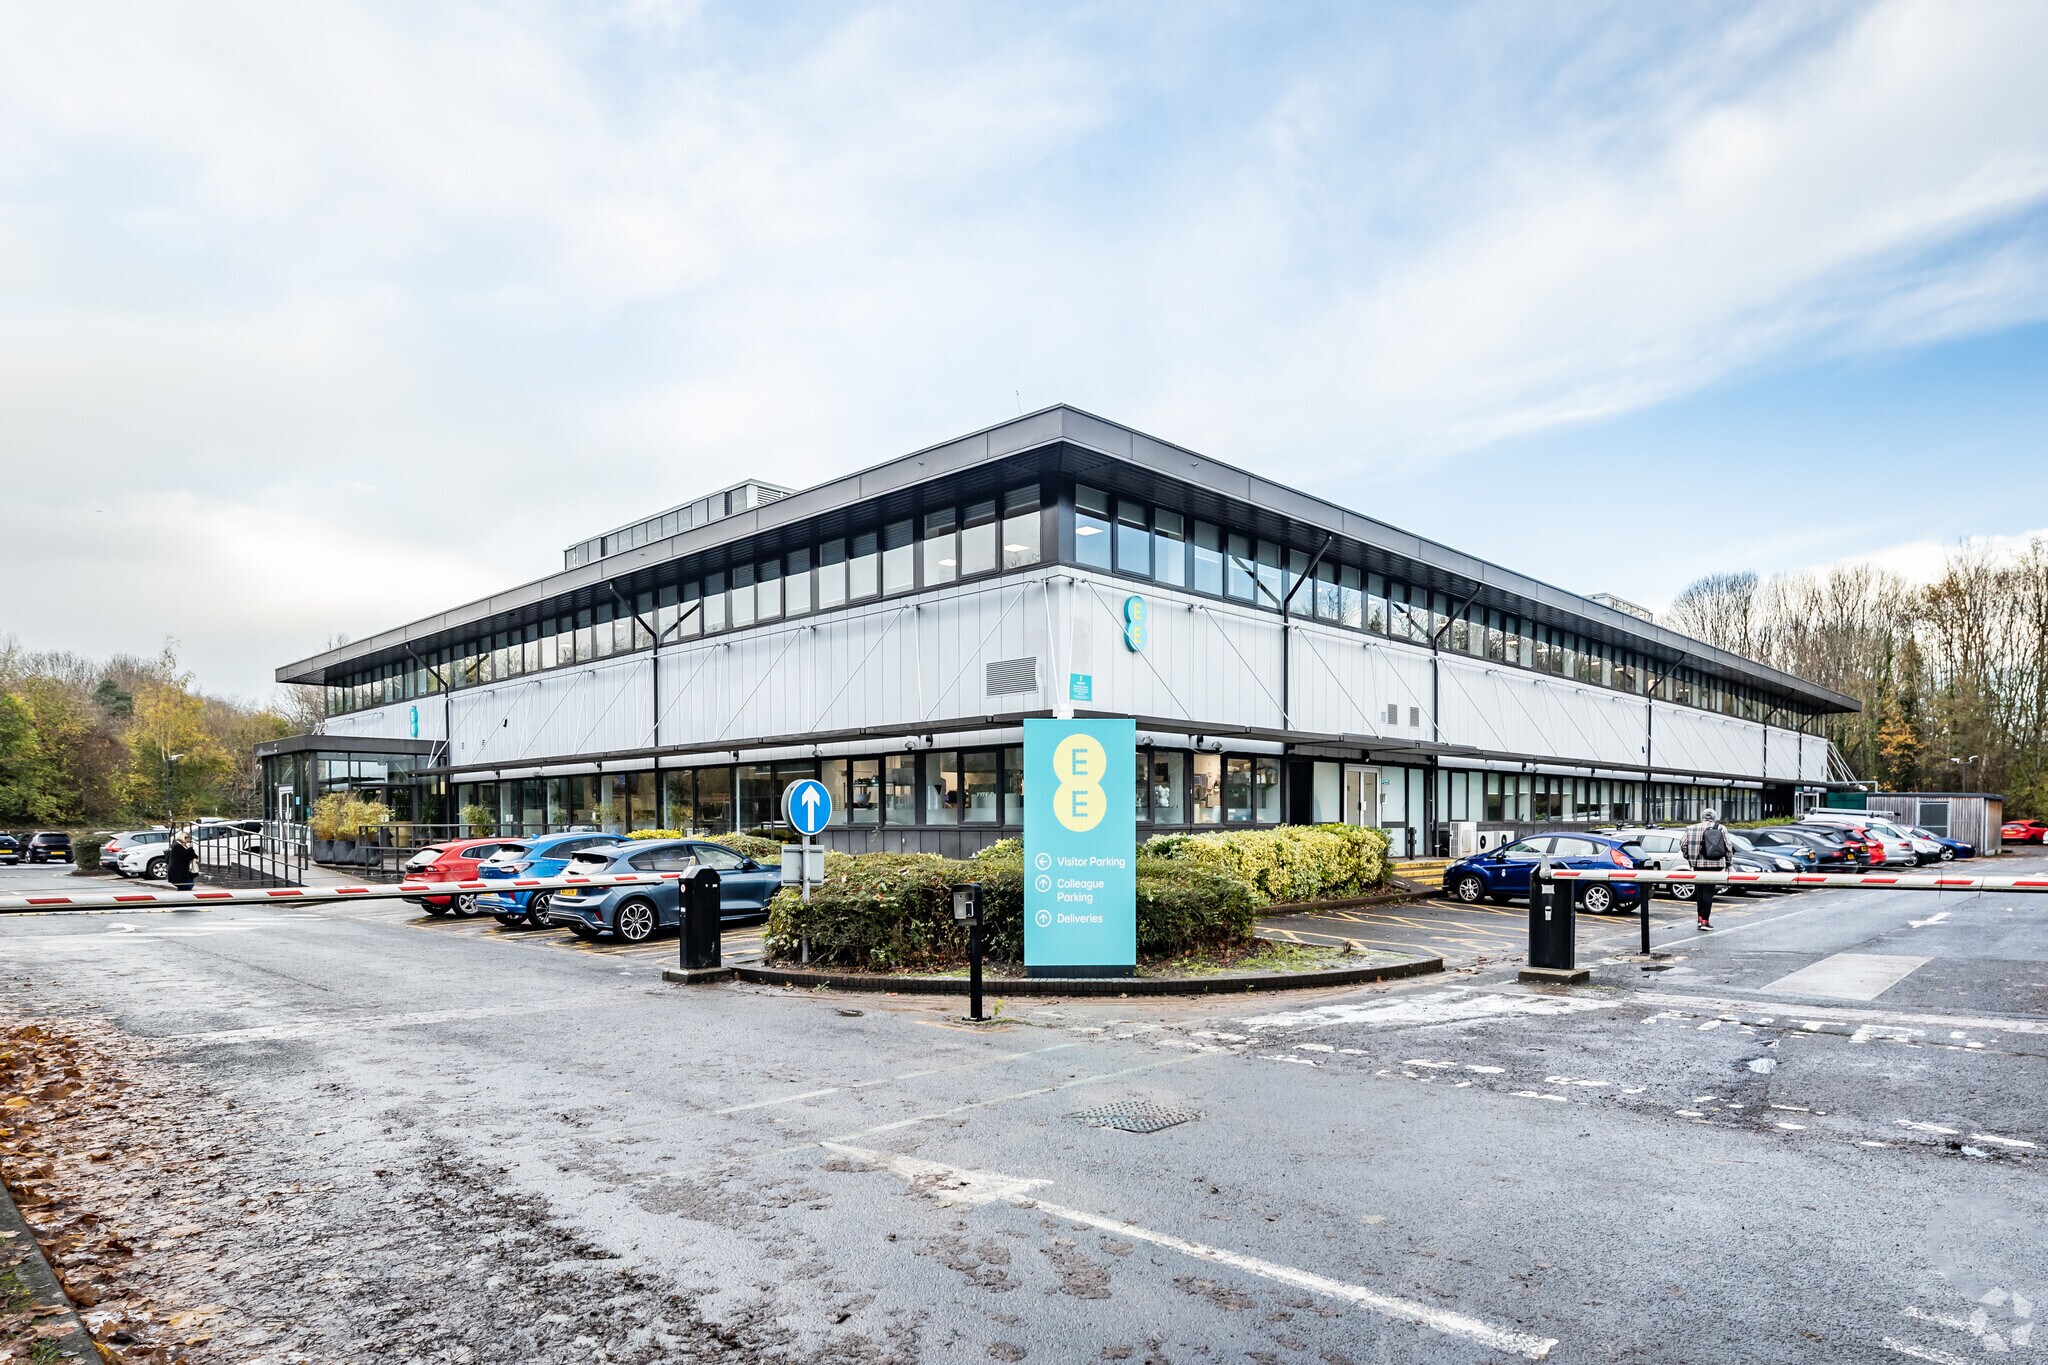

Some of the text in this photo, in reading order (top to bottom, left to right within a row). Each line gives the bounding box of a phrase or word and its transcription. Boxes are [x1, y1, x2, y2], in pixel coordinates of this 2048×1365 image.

[1072, 748, 1088, 817] EE
[1057, 857, 1126, 869] Visitor Parking
[1057, 878, 1104, 891] Colleague
[1057, 892, 1093, 904] Parking
[1057, 913, 1103, 923] Deliveries
